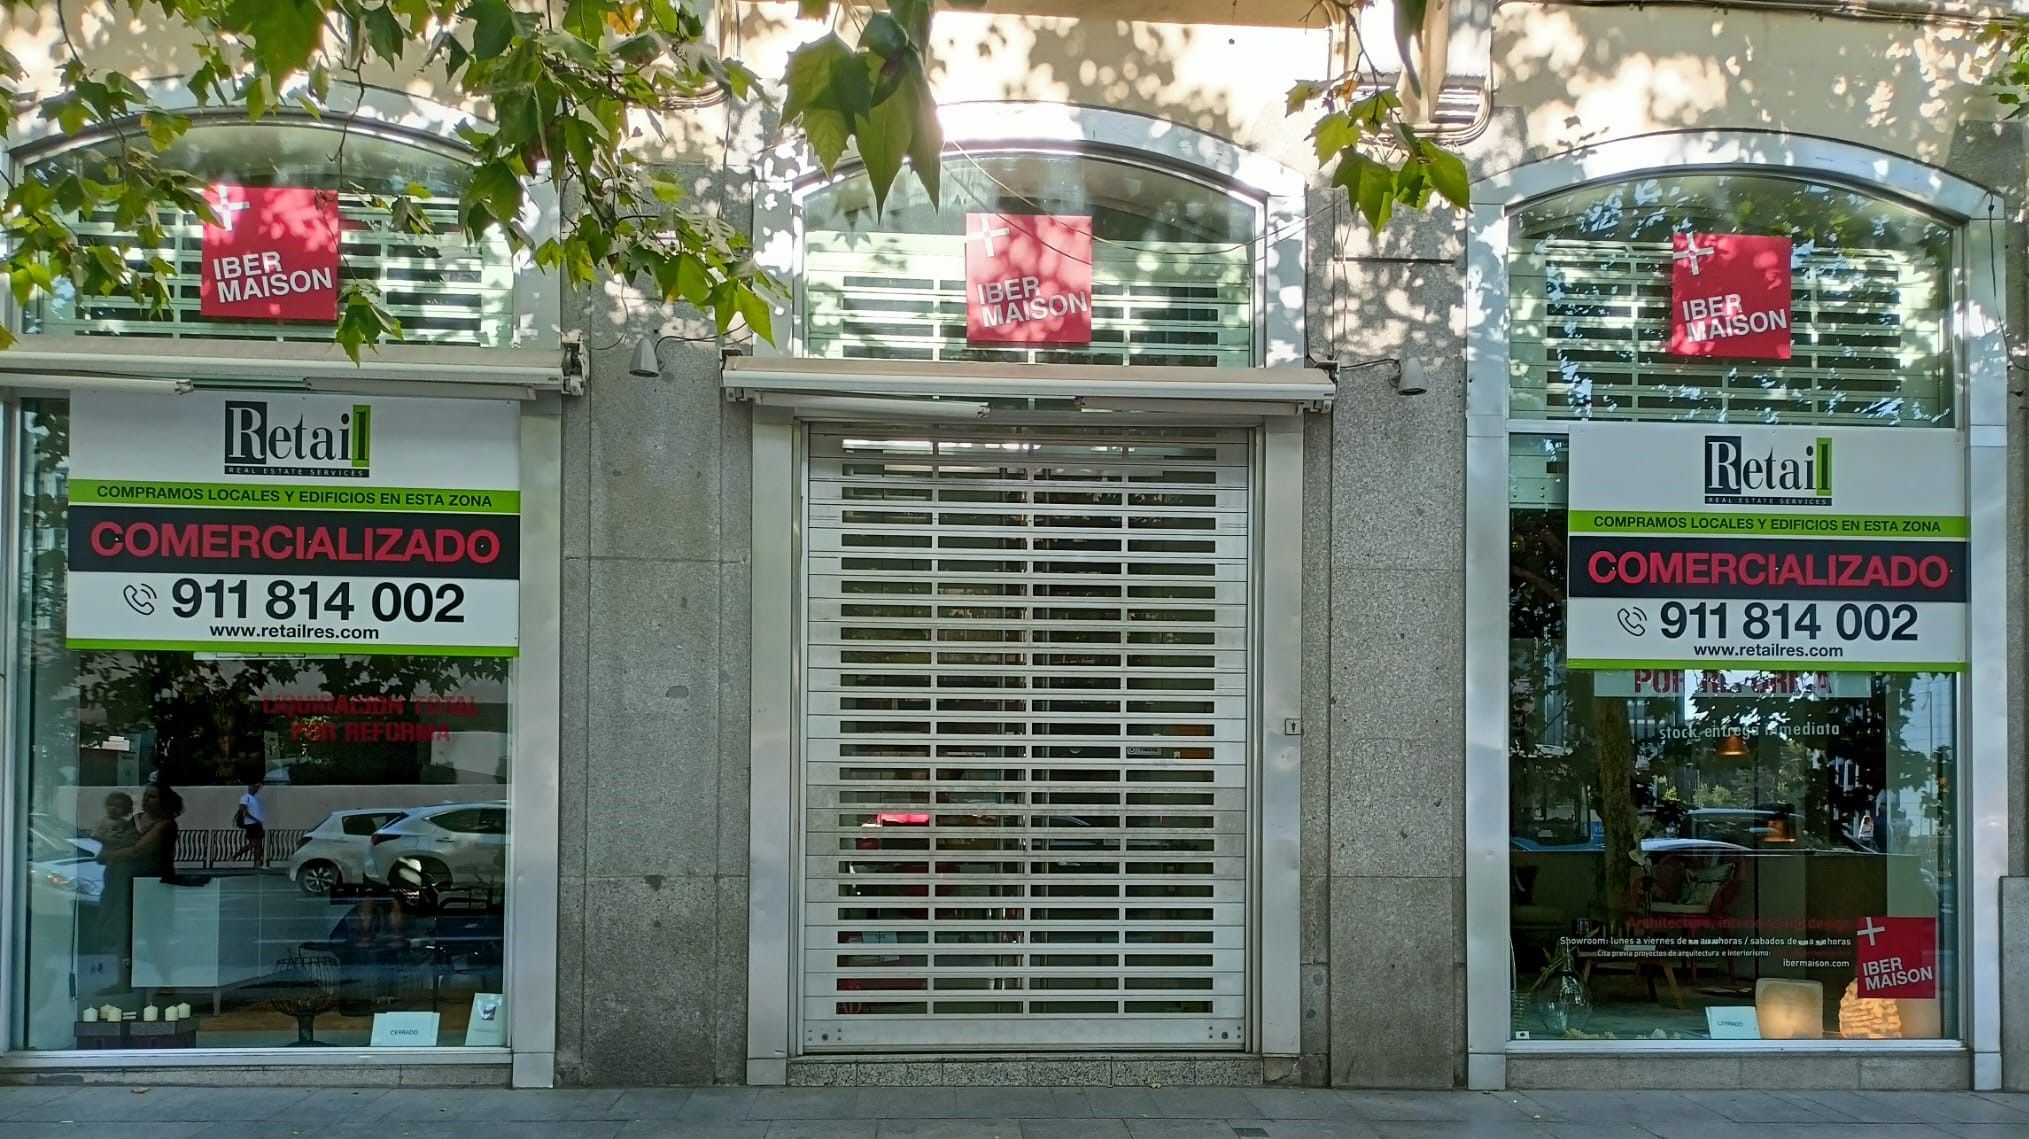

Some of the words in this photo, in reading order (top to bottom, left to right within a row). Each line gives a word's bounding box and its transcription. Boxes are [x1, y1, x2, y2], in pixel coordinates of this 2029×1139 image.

[213, 251, 282, 280] IBER
[217, 267, 332, 303] MAISON
[976, 276, 1040, 305] IBER
[981, 291, 1088, 328] MAISON
[1682, 294, 1742, 321] IBER
[1686, 308, 1787, 343] MAISON
[228, 407, 368, 461] Retail
[263, 468, 303, 476] ESTATE
[310, 469, 364, 477] SERVICES
[1708, 441, 1830, 490] Retail
[97, 485, 204, 500] COMPRAMOS
[208, 489, 280, 502] LOCALES
[284, 490, 295, 502] Y
[299, 491, 376, 504] EDIFICIOS
[380, 493, 401, 505] EN
[405, 493, 445, 506] ESTA
[449, 494, 492, 507] ZONA
[1594, 515, 1687, 528] COMPRAMOS
[1691, 517, 1754, 529] LOCALES
[1758, 518, 1767, 529] Y
[1771, 519, 1838, 531] EDIFICIOS
[1842, 520, 1860, 531] EN
[1864, 520, 1899, 532] ESTA
[1902, 521, 1941, 532] ZONA
[90, 521, 501, 564] COMERCIALIZADO
[1587, 550, 1949, 589] COMERCIALIZADO
[172, 577, 248, 619] 911
[265, 579, 355, 621] 814
[371, 581, 465, 623] 002
[209, 624, 379, 640] www.retailres.com
[1660, 601, 1727, 639] 911
[1742, 602, 1822, 640] 814
[1836, 603, 1918, 641] 002
[1694, 643, 1844, 657] www.retailres.com
[290, 721, 339, 743] POR
[344, 721, 451, 743] REFORMA
[1704, 725, 1759, 740] entrega
[1560, 936, 1609, 945] Showroom:
[1611, 936, 1634, 945] lunes
[1643, 936, 1675, 945] viernes
[1677, 936, 1687, 945] de
[1750, 937, 1784, 945] sabados
[1634, 950, 1667, 958] proyectos
[1678, 950, 1719, 959] arquitectura
[1783, 959, 1849, 967] ibermaison.com
[1863, 957, 1902, 976] IBER
[1866, 966, 1933, 991] MAISON
